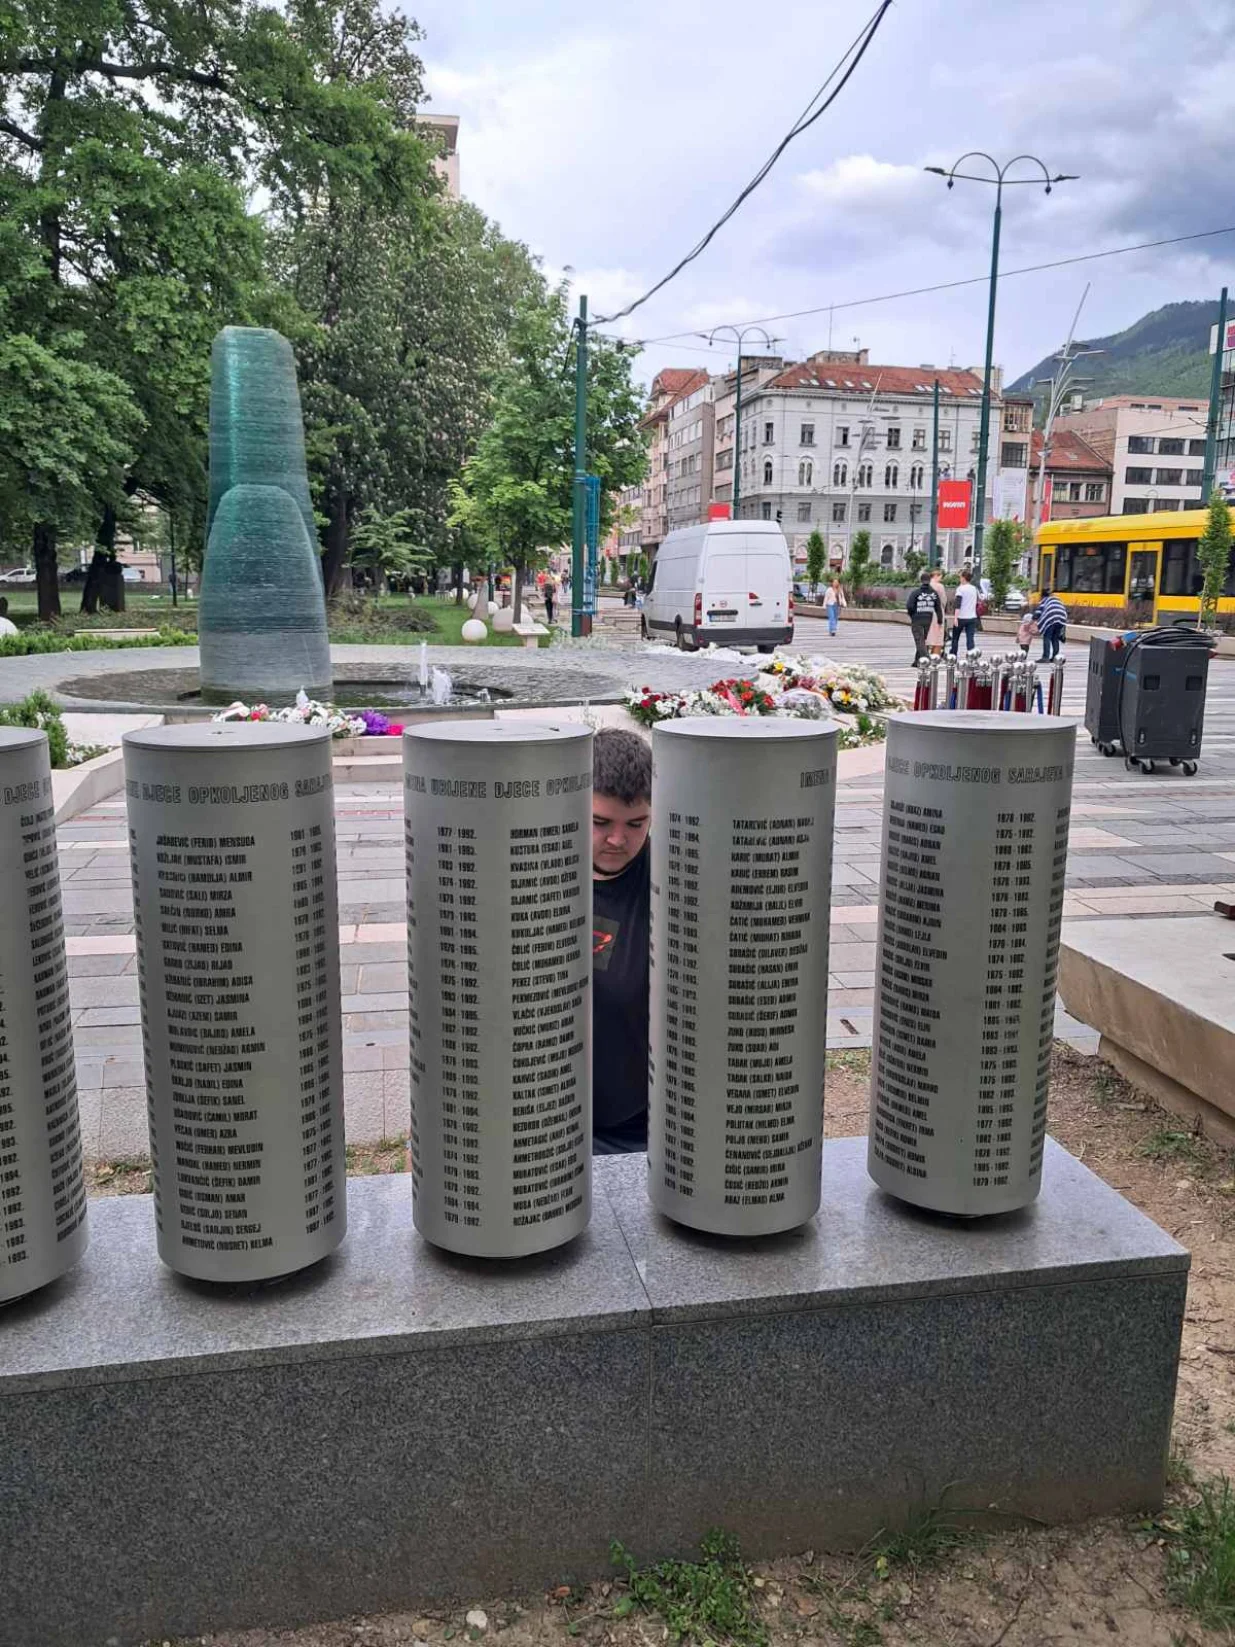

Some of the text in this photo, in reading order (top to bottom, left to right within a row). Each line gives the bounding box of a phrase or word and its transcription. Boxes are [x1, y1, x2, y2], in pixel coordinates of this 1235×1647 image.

[914, 761, 1001, 783] OPKOLJENOG
[189, 782, 288, 804] OPKOLJENOG
[431, 779, 486, 798] UBIJENE
[495, 781, 540, 798] DJECE
[458, 828, 477, 839] 1992.
[511, 844, 539, 855] KUSTURA
[229, 872, 252, 881] ALMIR
[210, 891, 232, 900] MIRZA
[205, 926, 228, 935] SELMA
[216, 993, 249, 1004] JASMINA
[214, 1012, 237, 1021] SAMIR
[231, 1027, 255, 1037] AMELA
[224, 1061, 251, 1072] JASMIN
[513, 1089, 535, 1100] KALTAK
[220, 1129, 237, 1138] AZRA
[228, 1143, 263, 1154] MEVLUDIN
[233, 1160, 261, 1170] NERMIN
[513, 1165, 548, 1179] MURATOVIĆ
[238, 1176, 260, 1186] DAMIR
[513, 1180, 548, 1194] MURATOVIĆ
[236, 1223, 261, 1234] SERGEJ
